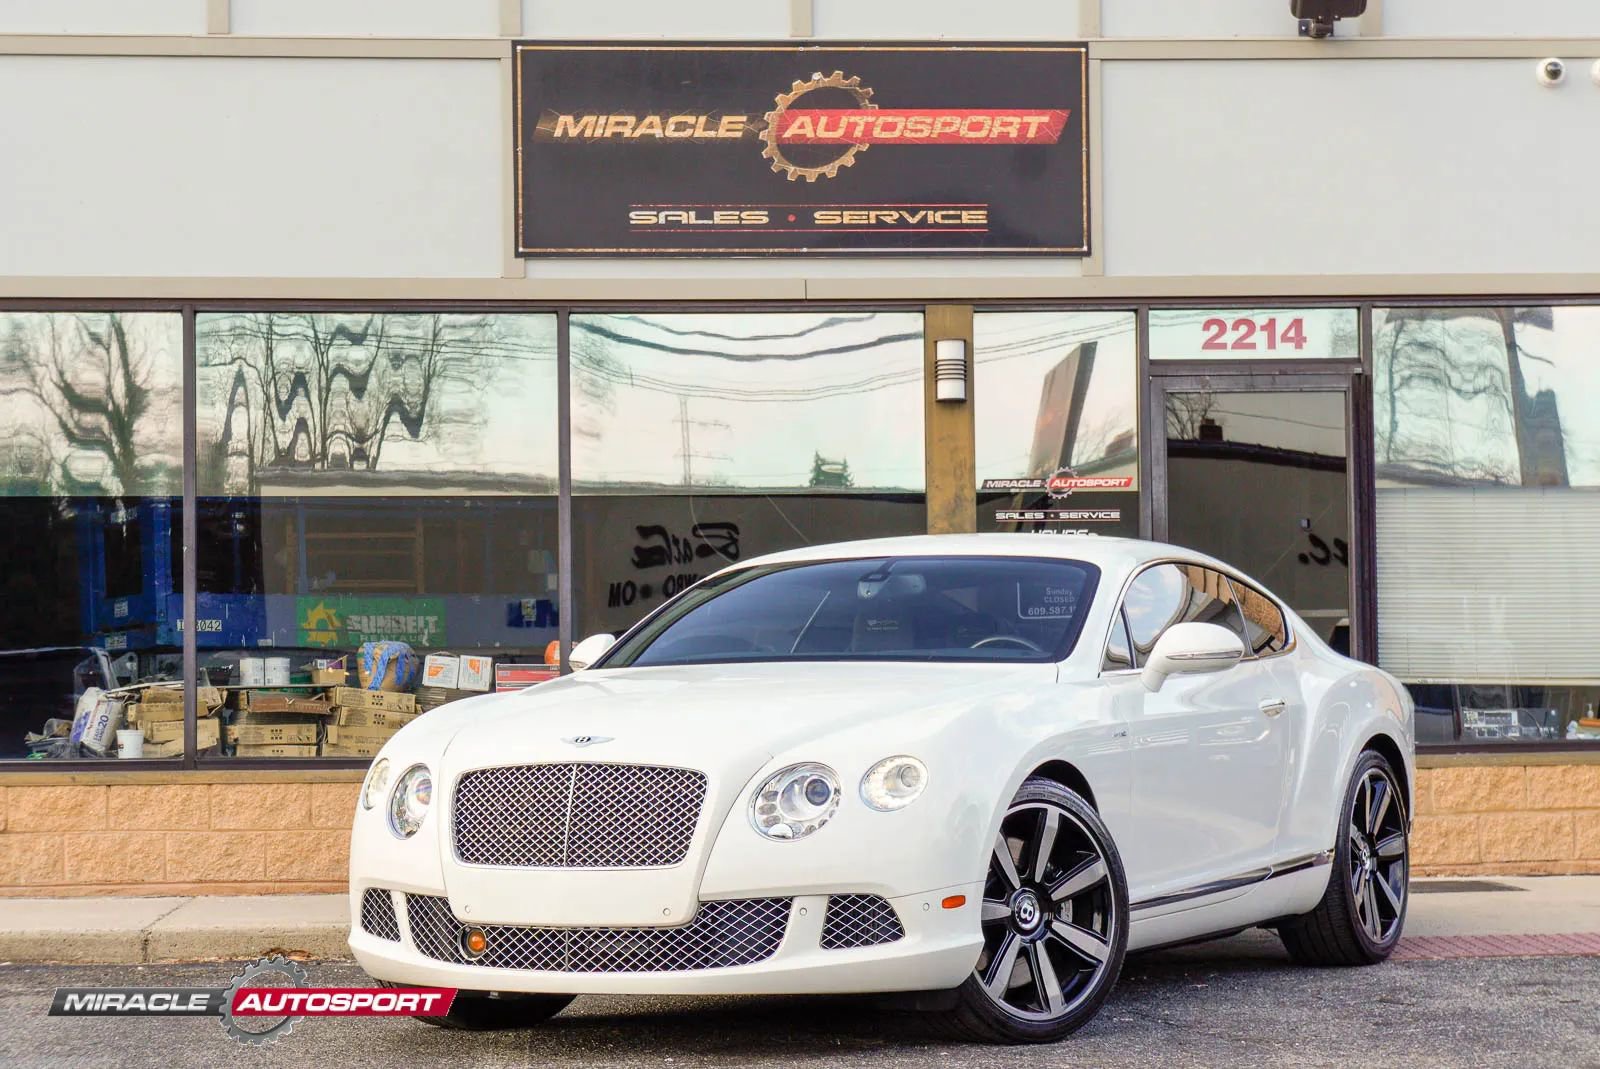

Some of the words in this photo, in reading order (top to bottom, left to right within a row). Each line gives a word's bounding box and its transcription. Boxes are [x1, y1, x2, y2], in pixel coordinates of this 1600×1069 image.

[552, 114, 748, 139] MIRACLE
[781, 114, 1051, 139] AUTOSPORT
[629, 210, 769, 225] SALES
[814, 209, 988, 225] SERVICE
[1201, 318, 1307, 350] 2214
[986, 480, 1042, 489] MIRACLE
[1050, 478, 1129, 488] AUTOSPORT
[995, 512, 1045, 520] SALES
[1059, 511, 1121, 519] SERVICE
